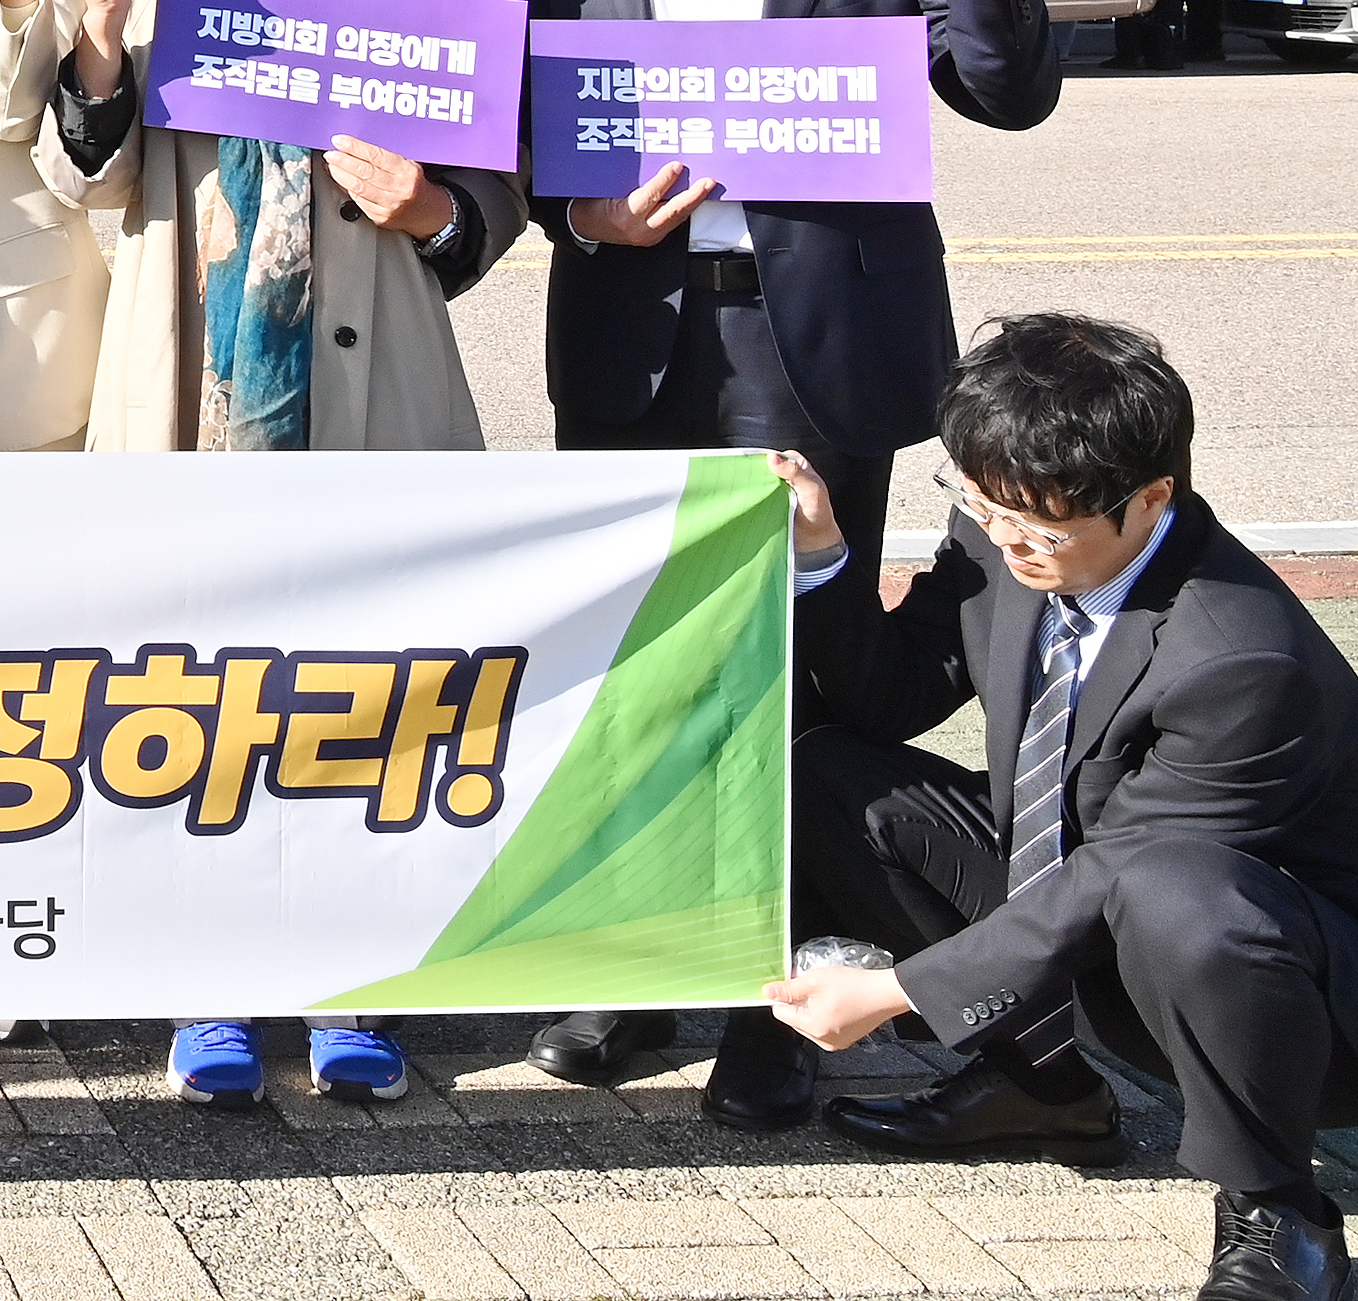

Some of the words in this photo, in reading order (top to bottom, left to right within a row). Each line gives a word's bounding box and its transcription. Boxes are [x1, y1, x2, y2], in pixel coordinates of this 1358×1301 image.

[197, 6, 328, 57] 지방의회
[333, 25, 477, 76] 의장에게
[189, 54, 322, 104] 조직권을
[328, 72, 475, 125] 부여하라!
[577, 66, 716, 103] 지방의회
[724, 65, 878, 103] 의장에게
[577, 117, 715, 154] 조직권을
[723, 116, 881, 155] 부여하라!
